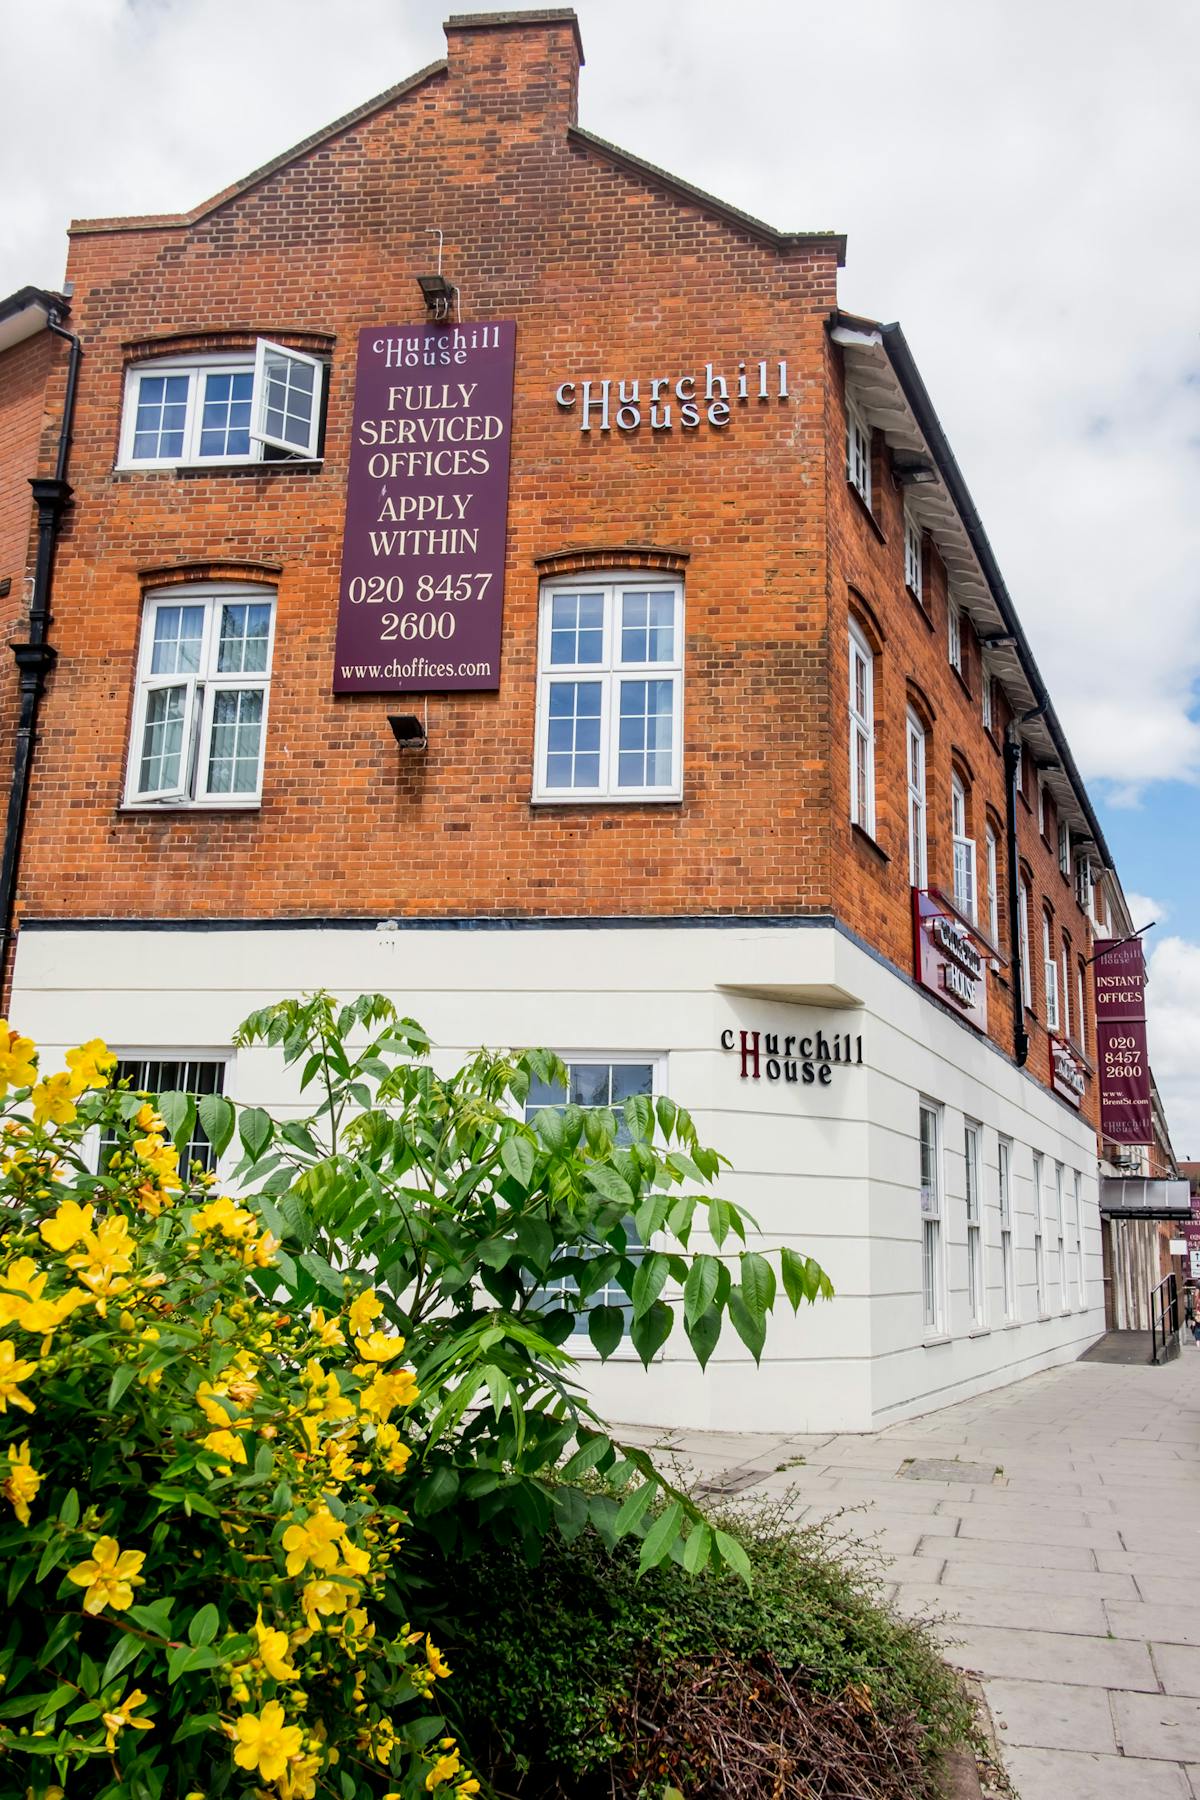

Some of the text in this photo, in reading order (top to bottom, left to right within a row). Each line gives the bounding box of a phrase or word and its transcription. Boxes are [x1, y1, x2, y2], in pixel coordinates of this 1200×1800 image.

[385, 343, 468, 368] House
[388, 383, 478, 411] FULLY
[580, 388, 731, 431] House
[359, 415, 503, 446] SERVICED
[368, 450, 490, 479] OFFICES
[378, 494, 473, 522] APPLY
[369, 528, 480, 557] WITHIN
[349, 573, 493, 604] 020 8457
[380, 612, 456, 641] 2600
[340, 657, 491, 679] www.choffices.com
[1097, 976, 1142, 987] INSTANT
[1098, 991, 1143, 1003] OFFICES
[1109, 1037, 1136, 1049] 020
[740, 1040, 832, 1085] House
[1105, 1051, 1141, 1065] 8457
[1106, 1066, 1142, 1078] 2600
